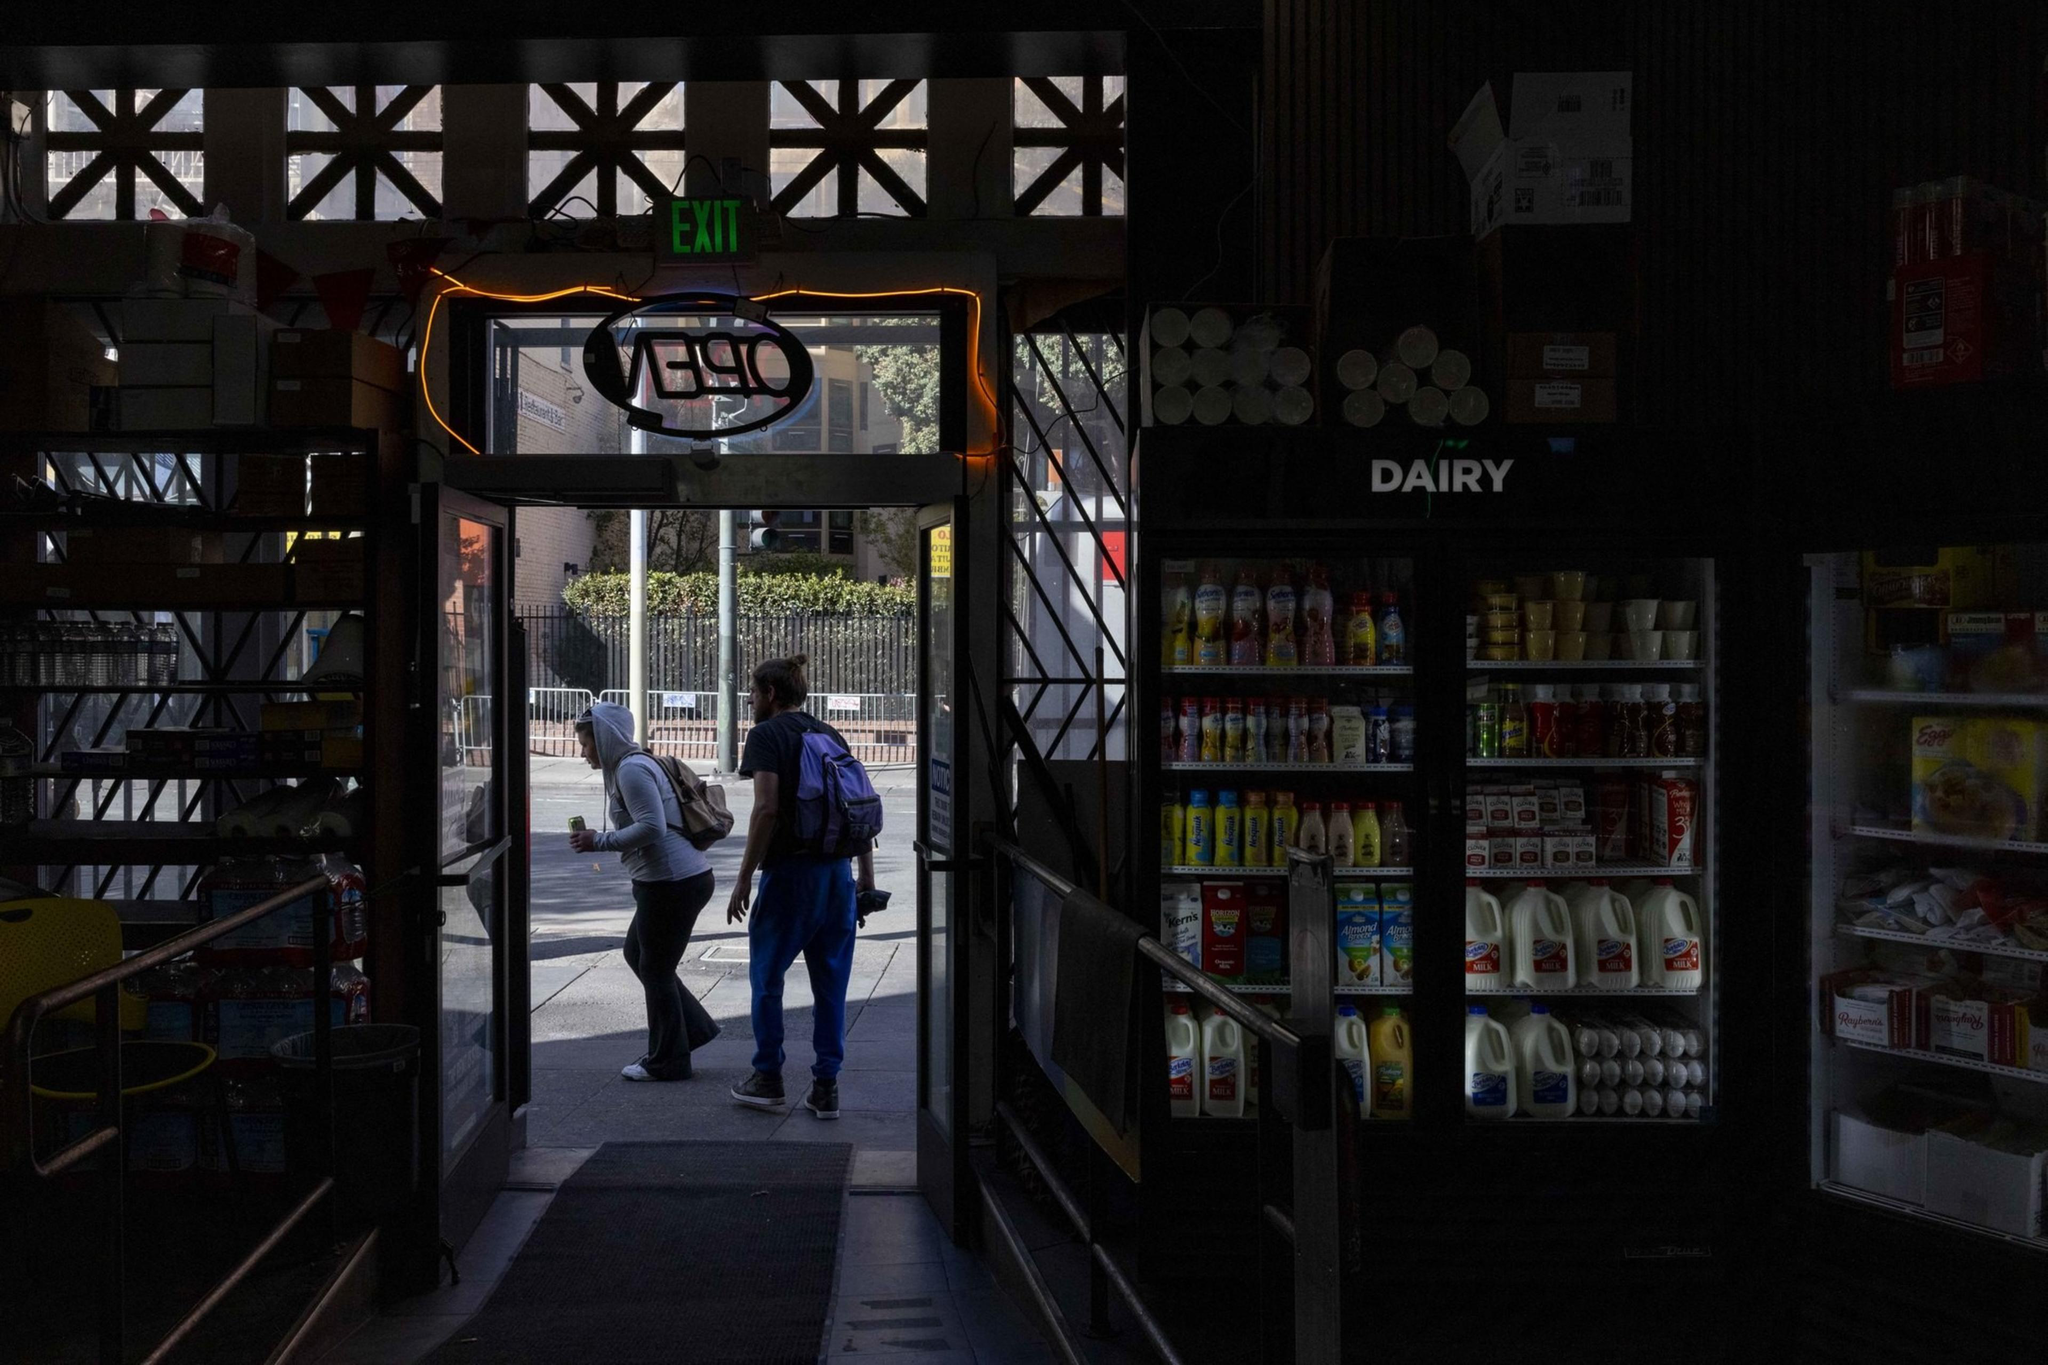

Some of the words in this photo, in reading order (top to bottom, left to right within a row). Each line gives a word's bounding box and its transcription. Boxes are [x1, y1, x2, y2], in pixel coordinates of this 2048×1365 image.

[671, 200, 741, 254] EXIT
[1371, 459, 1515, 493] DAIRY
[1193, 816, 1202, 847] Nesquik
[1225, 816, 1235, 847] Nesquik
[1248, 817, 1259, 848] Nesquik
[1276, 817, 1286, 848] Nesquik
[1168, 911, 1198, 928] Kern's
[1210, 909, 1240, 917] HORIZON
[1341, 921, 1377, 936] Almond
[1347, 932, 1373, 942] Breeze
[1473, 963, 1493, 971] MILK
[1541, 962, 1561, 970] MILK
[1605, 962, 1625, 970] MILK
[1838, 1011, 1884, 1029] Raybern's
